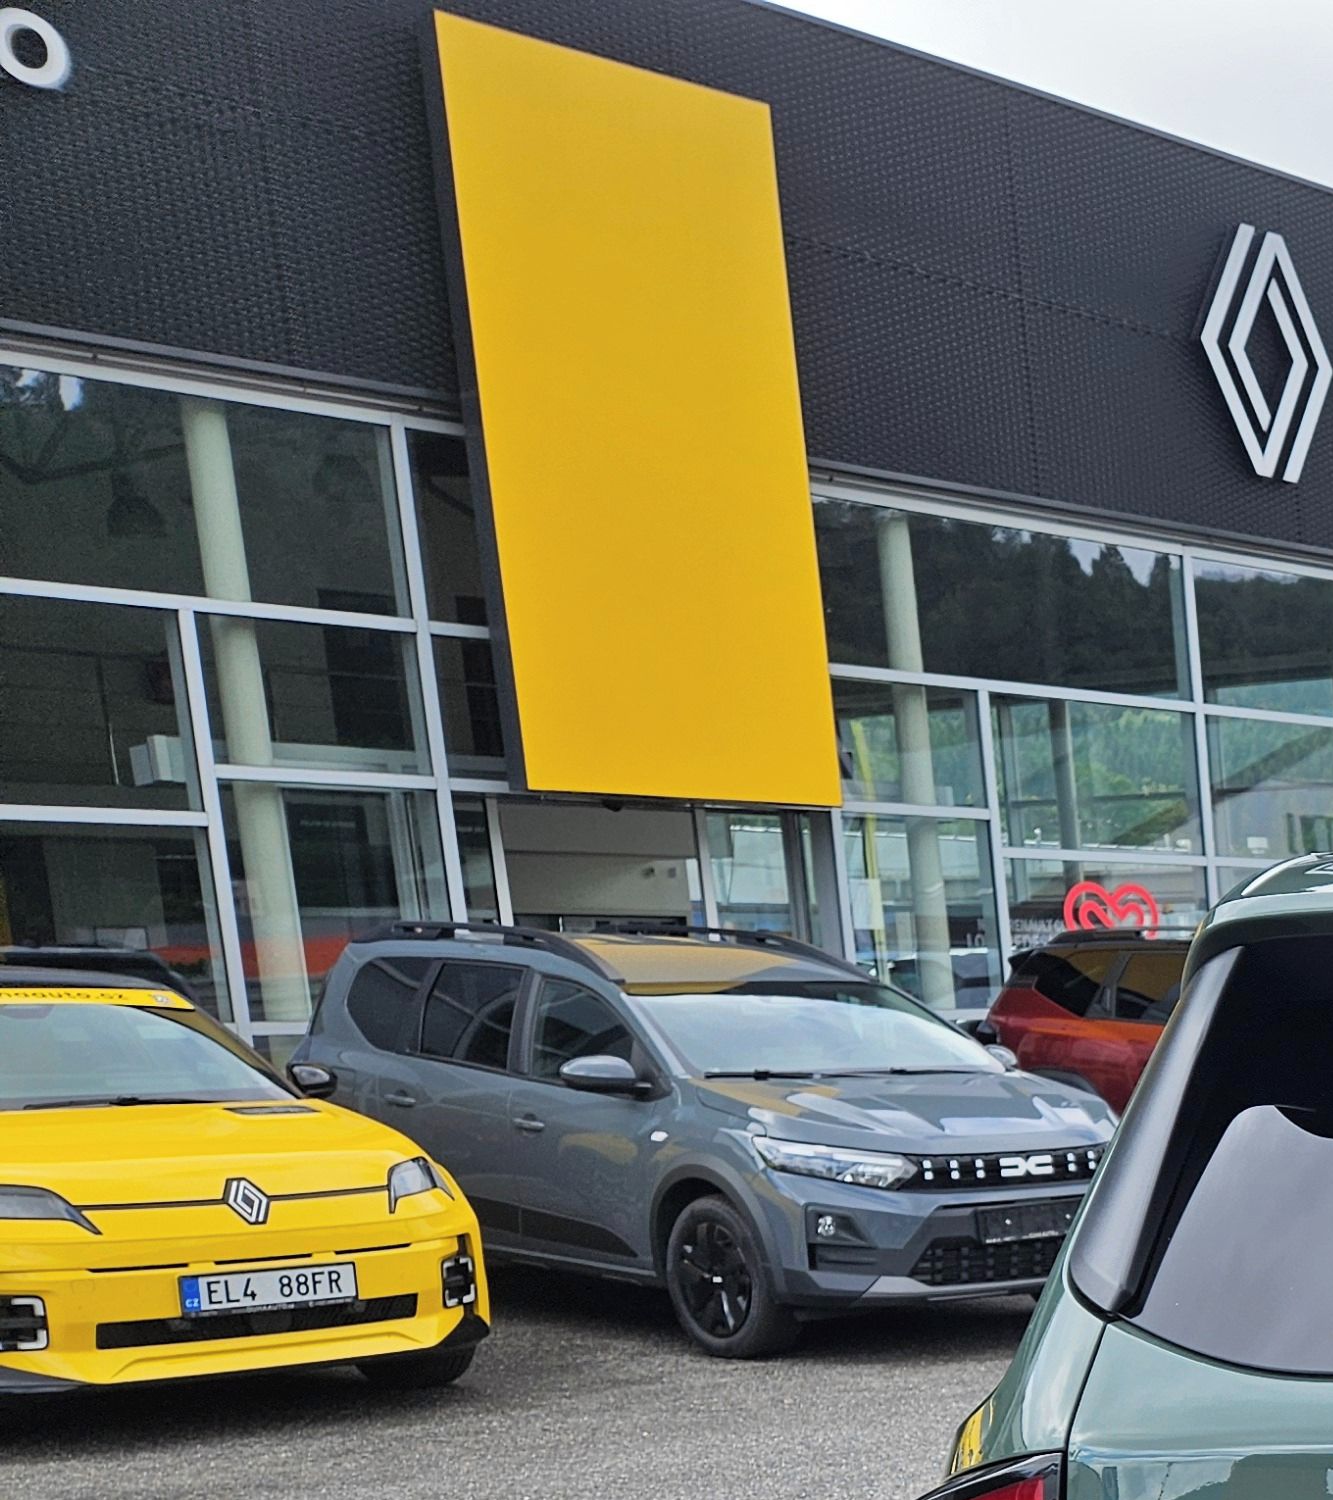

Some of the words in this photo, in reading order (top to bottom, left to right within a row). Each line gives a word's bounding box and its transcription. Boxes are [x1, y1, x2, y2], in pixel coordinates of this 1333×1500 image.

[206, 1278, 257, 1305] EL4
[279, 1270, 343, 1297] 88FR
[185, 1299, 199, 1308] CZ
